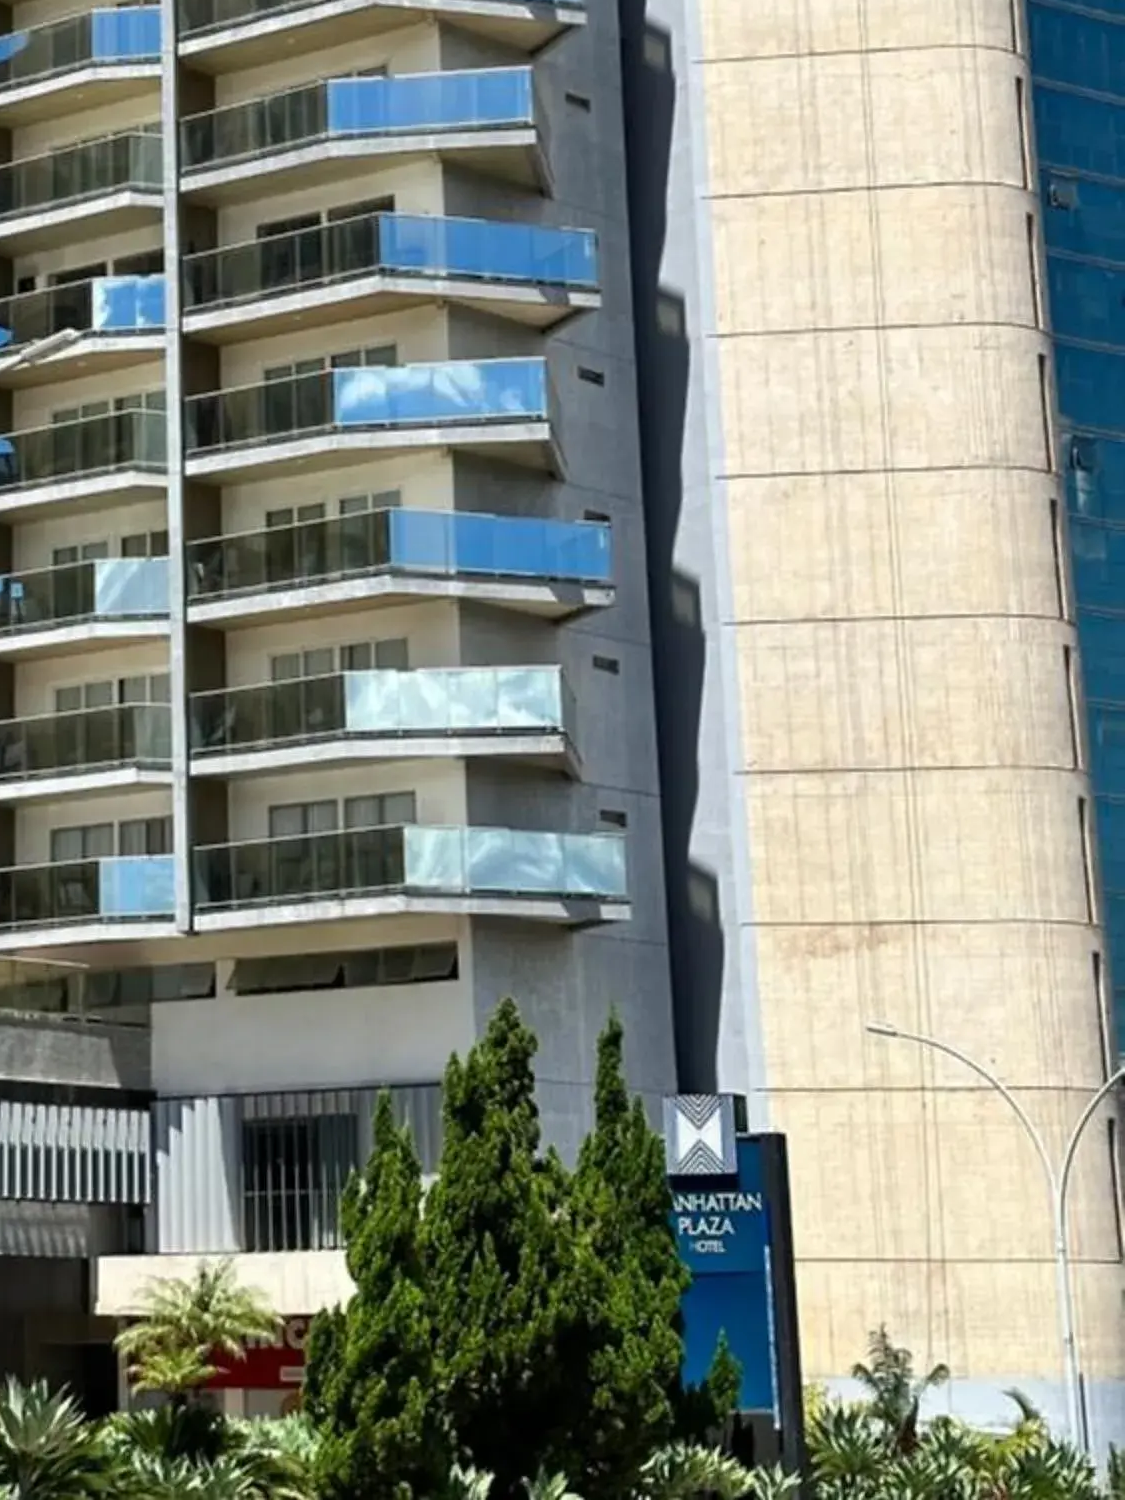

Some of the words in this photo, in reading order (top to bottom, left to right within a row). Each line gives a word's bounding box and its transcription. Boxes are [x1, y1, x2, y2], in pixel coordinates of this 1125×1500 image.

[673, 1192, 762, 1212] NHATTAN
[678, 1216, 735, 1236] PLAZA
[688, 1240, 726, 1252] HOTEL
